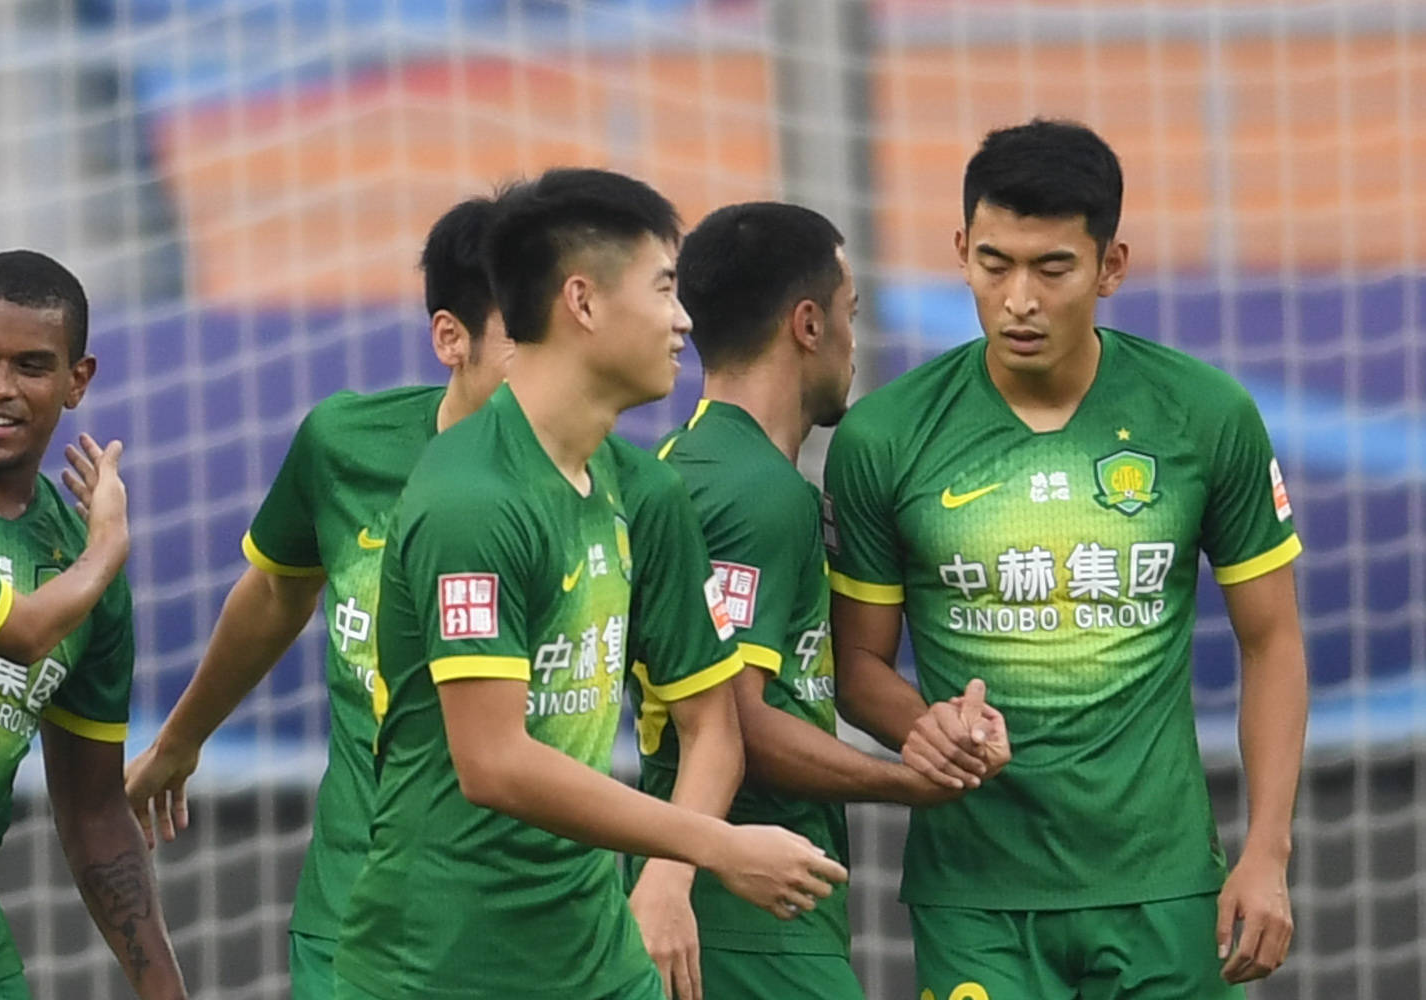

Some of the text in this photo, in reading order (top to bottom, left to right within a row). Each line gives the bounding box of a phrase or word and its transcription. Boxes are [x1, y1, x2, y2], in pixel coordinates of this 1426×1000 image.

[939, 542, 1175, 602] 中赫集团
[949, 600, 1165, 632] SINOBO GROUP
